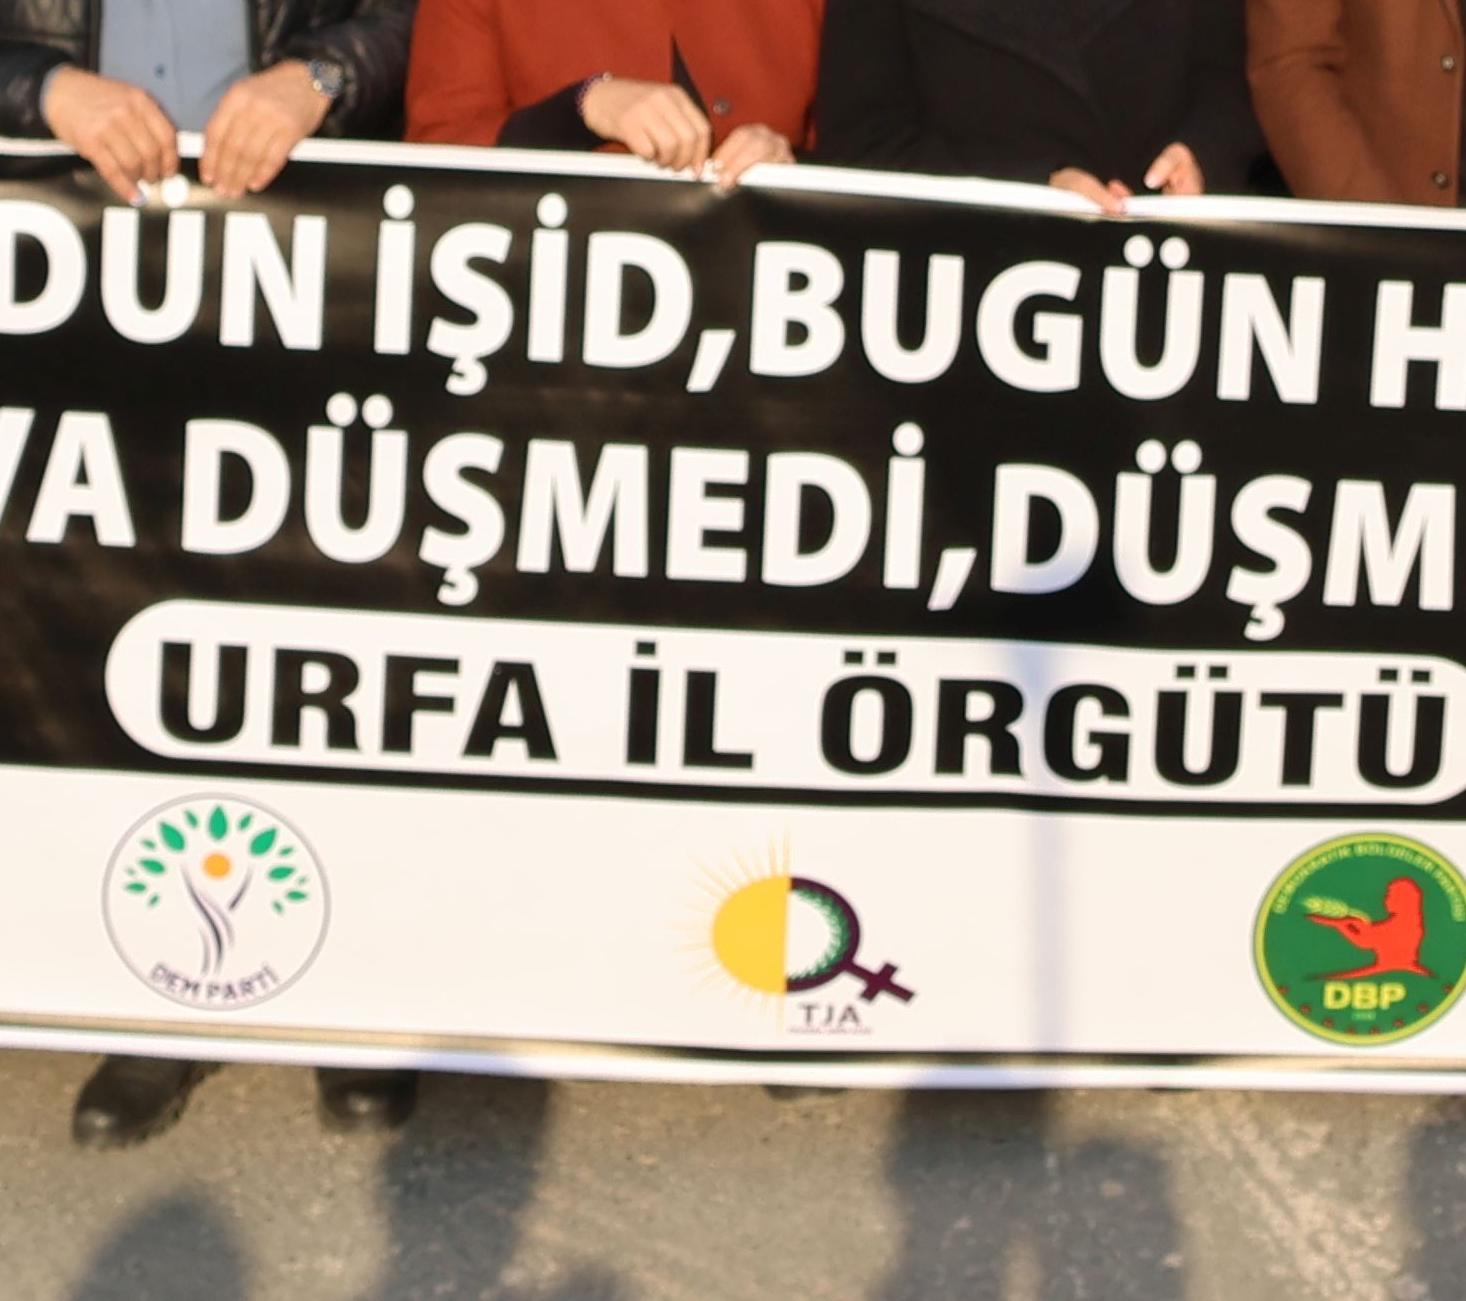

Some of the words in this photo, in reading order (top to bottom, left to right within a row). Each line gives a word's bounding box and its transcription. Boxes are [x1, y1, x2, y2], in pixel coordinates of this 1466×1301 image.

[155, 637, 560, 765] URFA
[622, 638, 758, 773] İL
[817, 647, 1451, 794] ÖRGÜTÜ
[1322, 980, 1408, 1011] DBP
[799, 1002, 860, 1027] TJA
